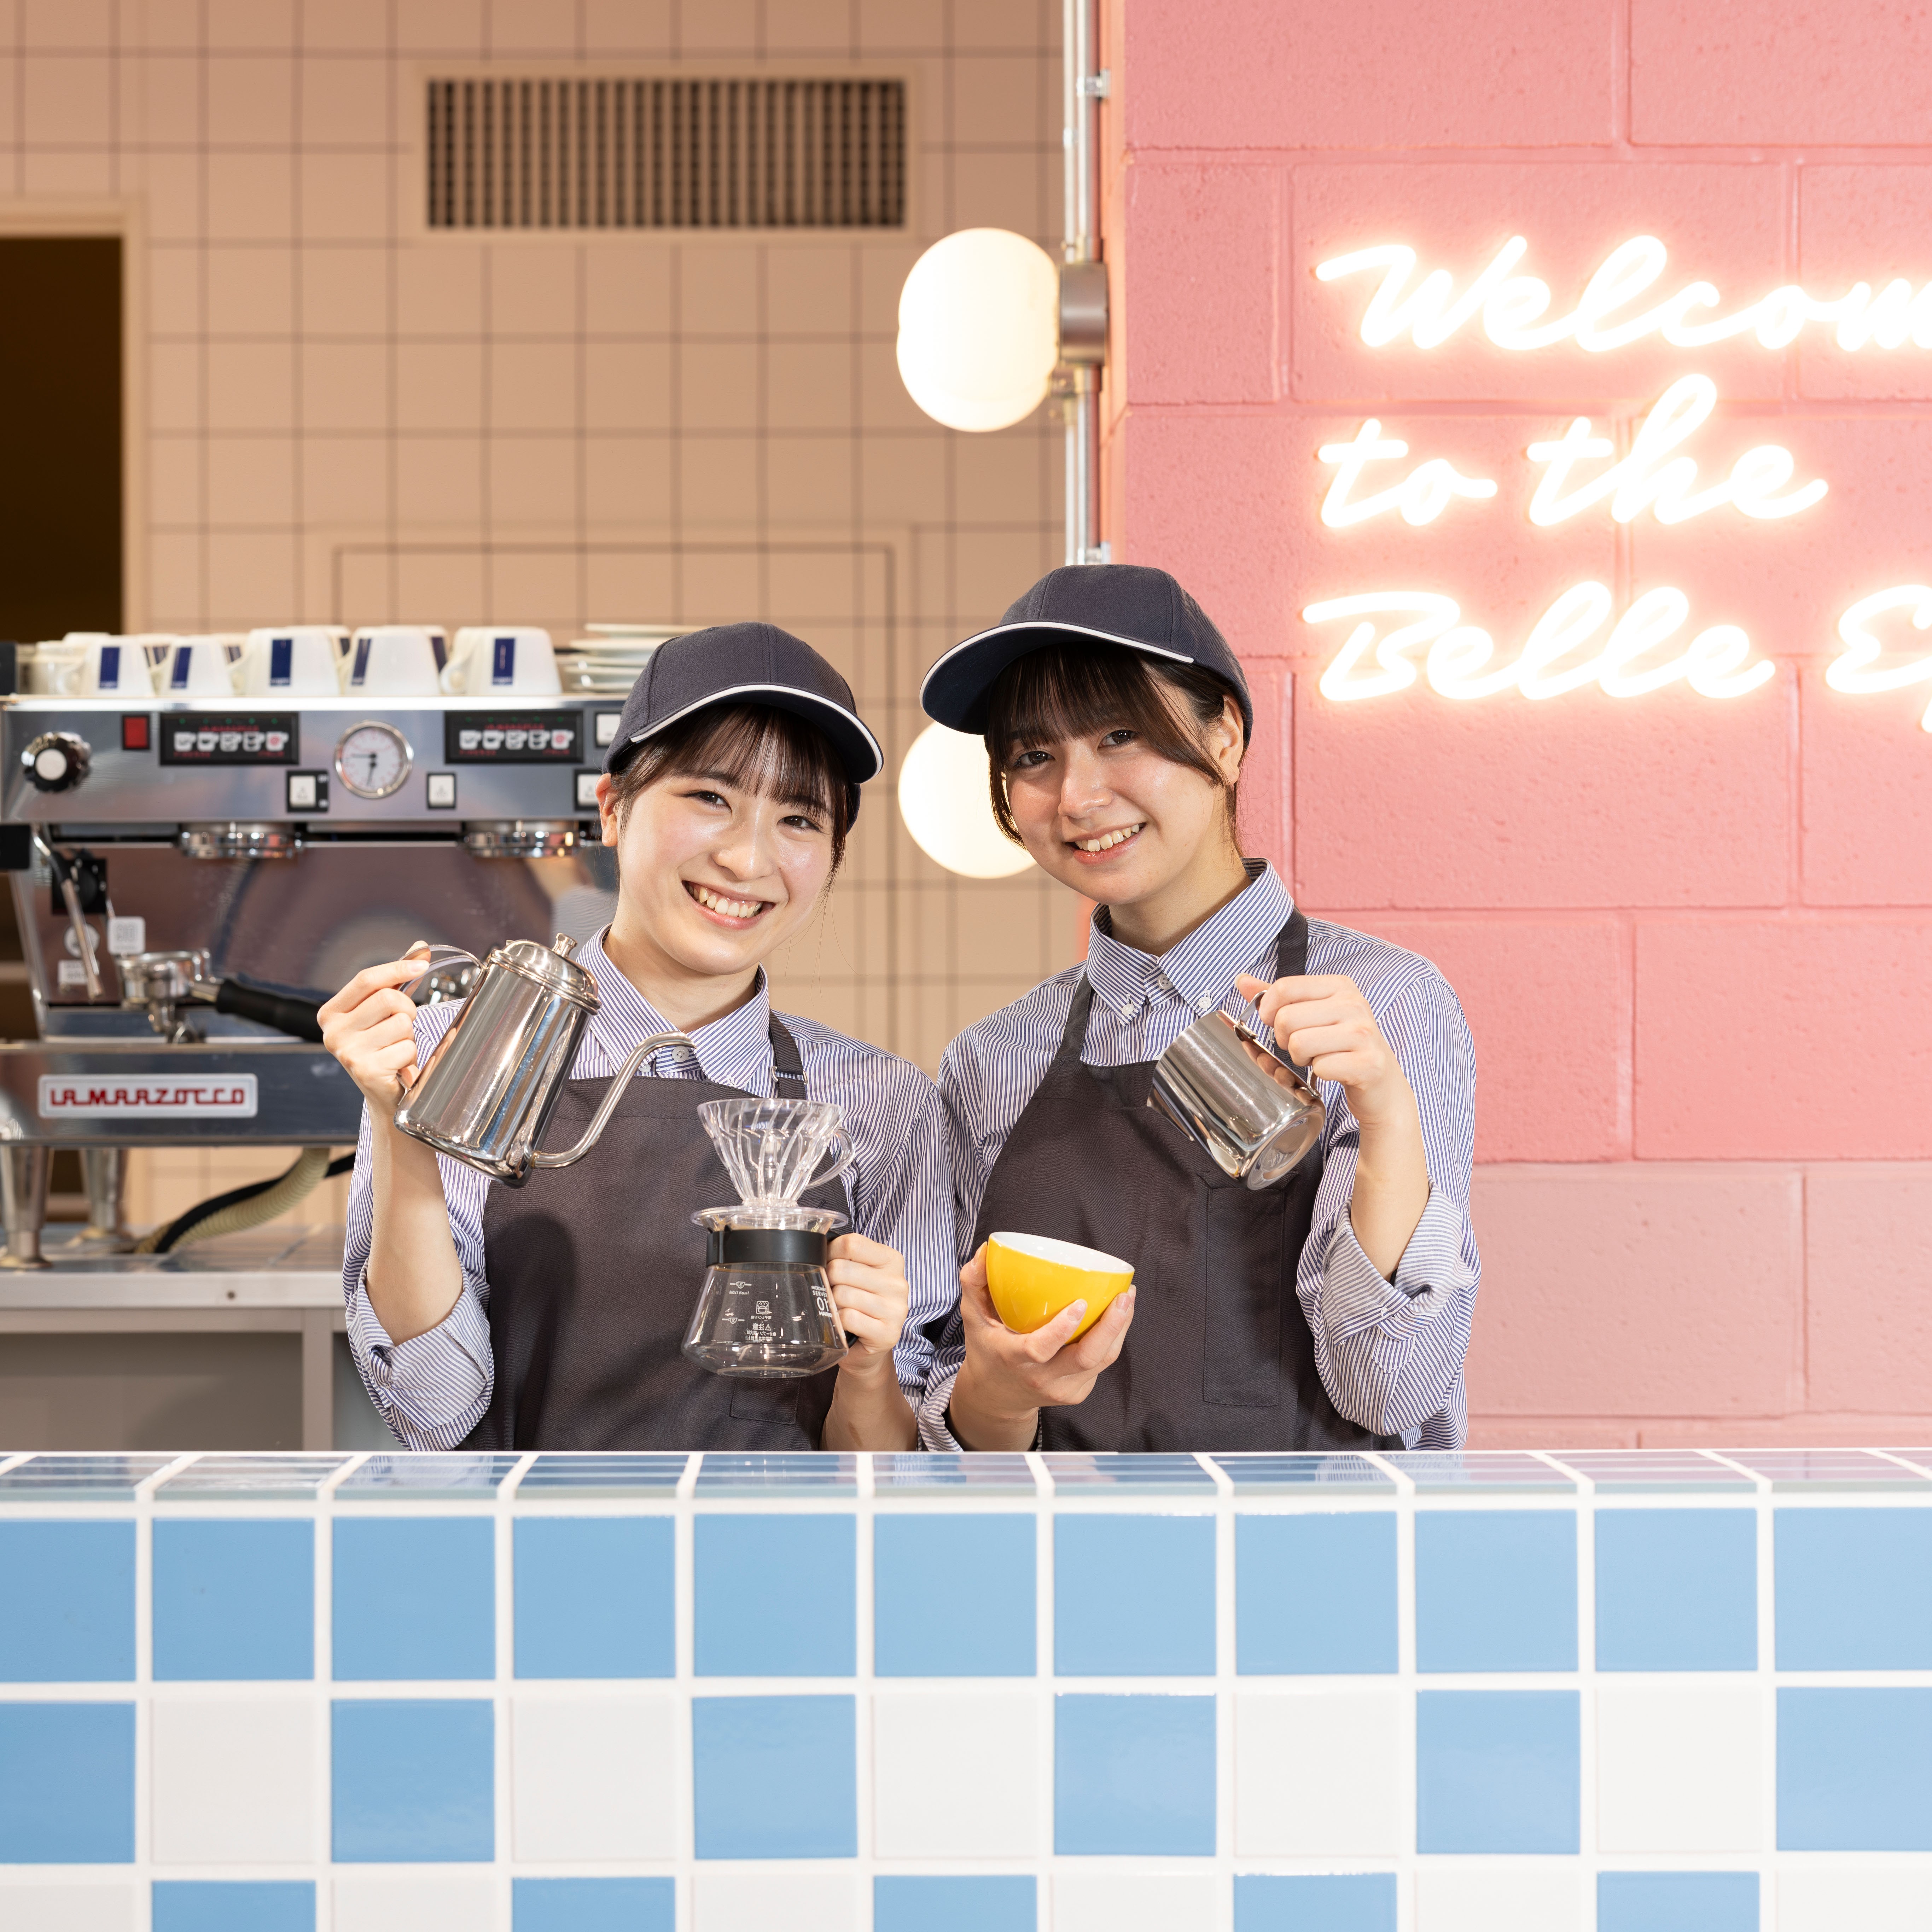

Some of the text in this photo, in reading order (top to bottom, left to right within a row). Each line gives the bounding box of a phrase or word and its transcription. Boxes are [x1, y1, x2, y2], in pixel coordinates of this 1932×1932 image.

[1319, 373, 1828, 528] to the
[1303, 581, 1932, 732] Belle E
[817, 1297, 829, 1312] 01
